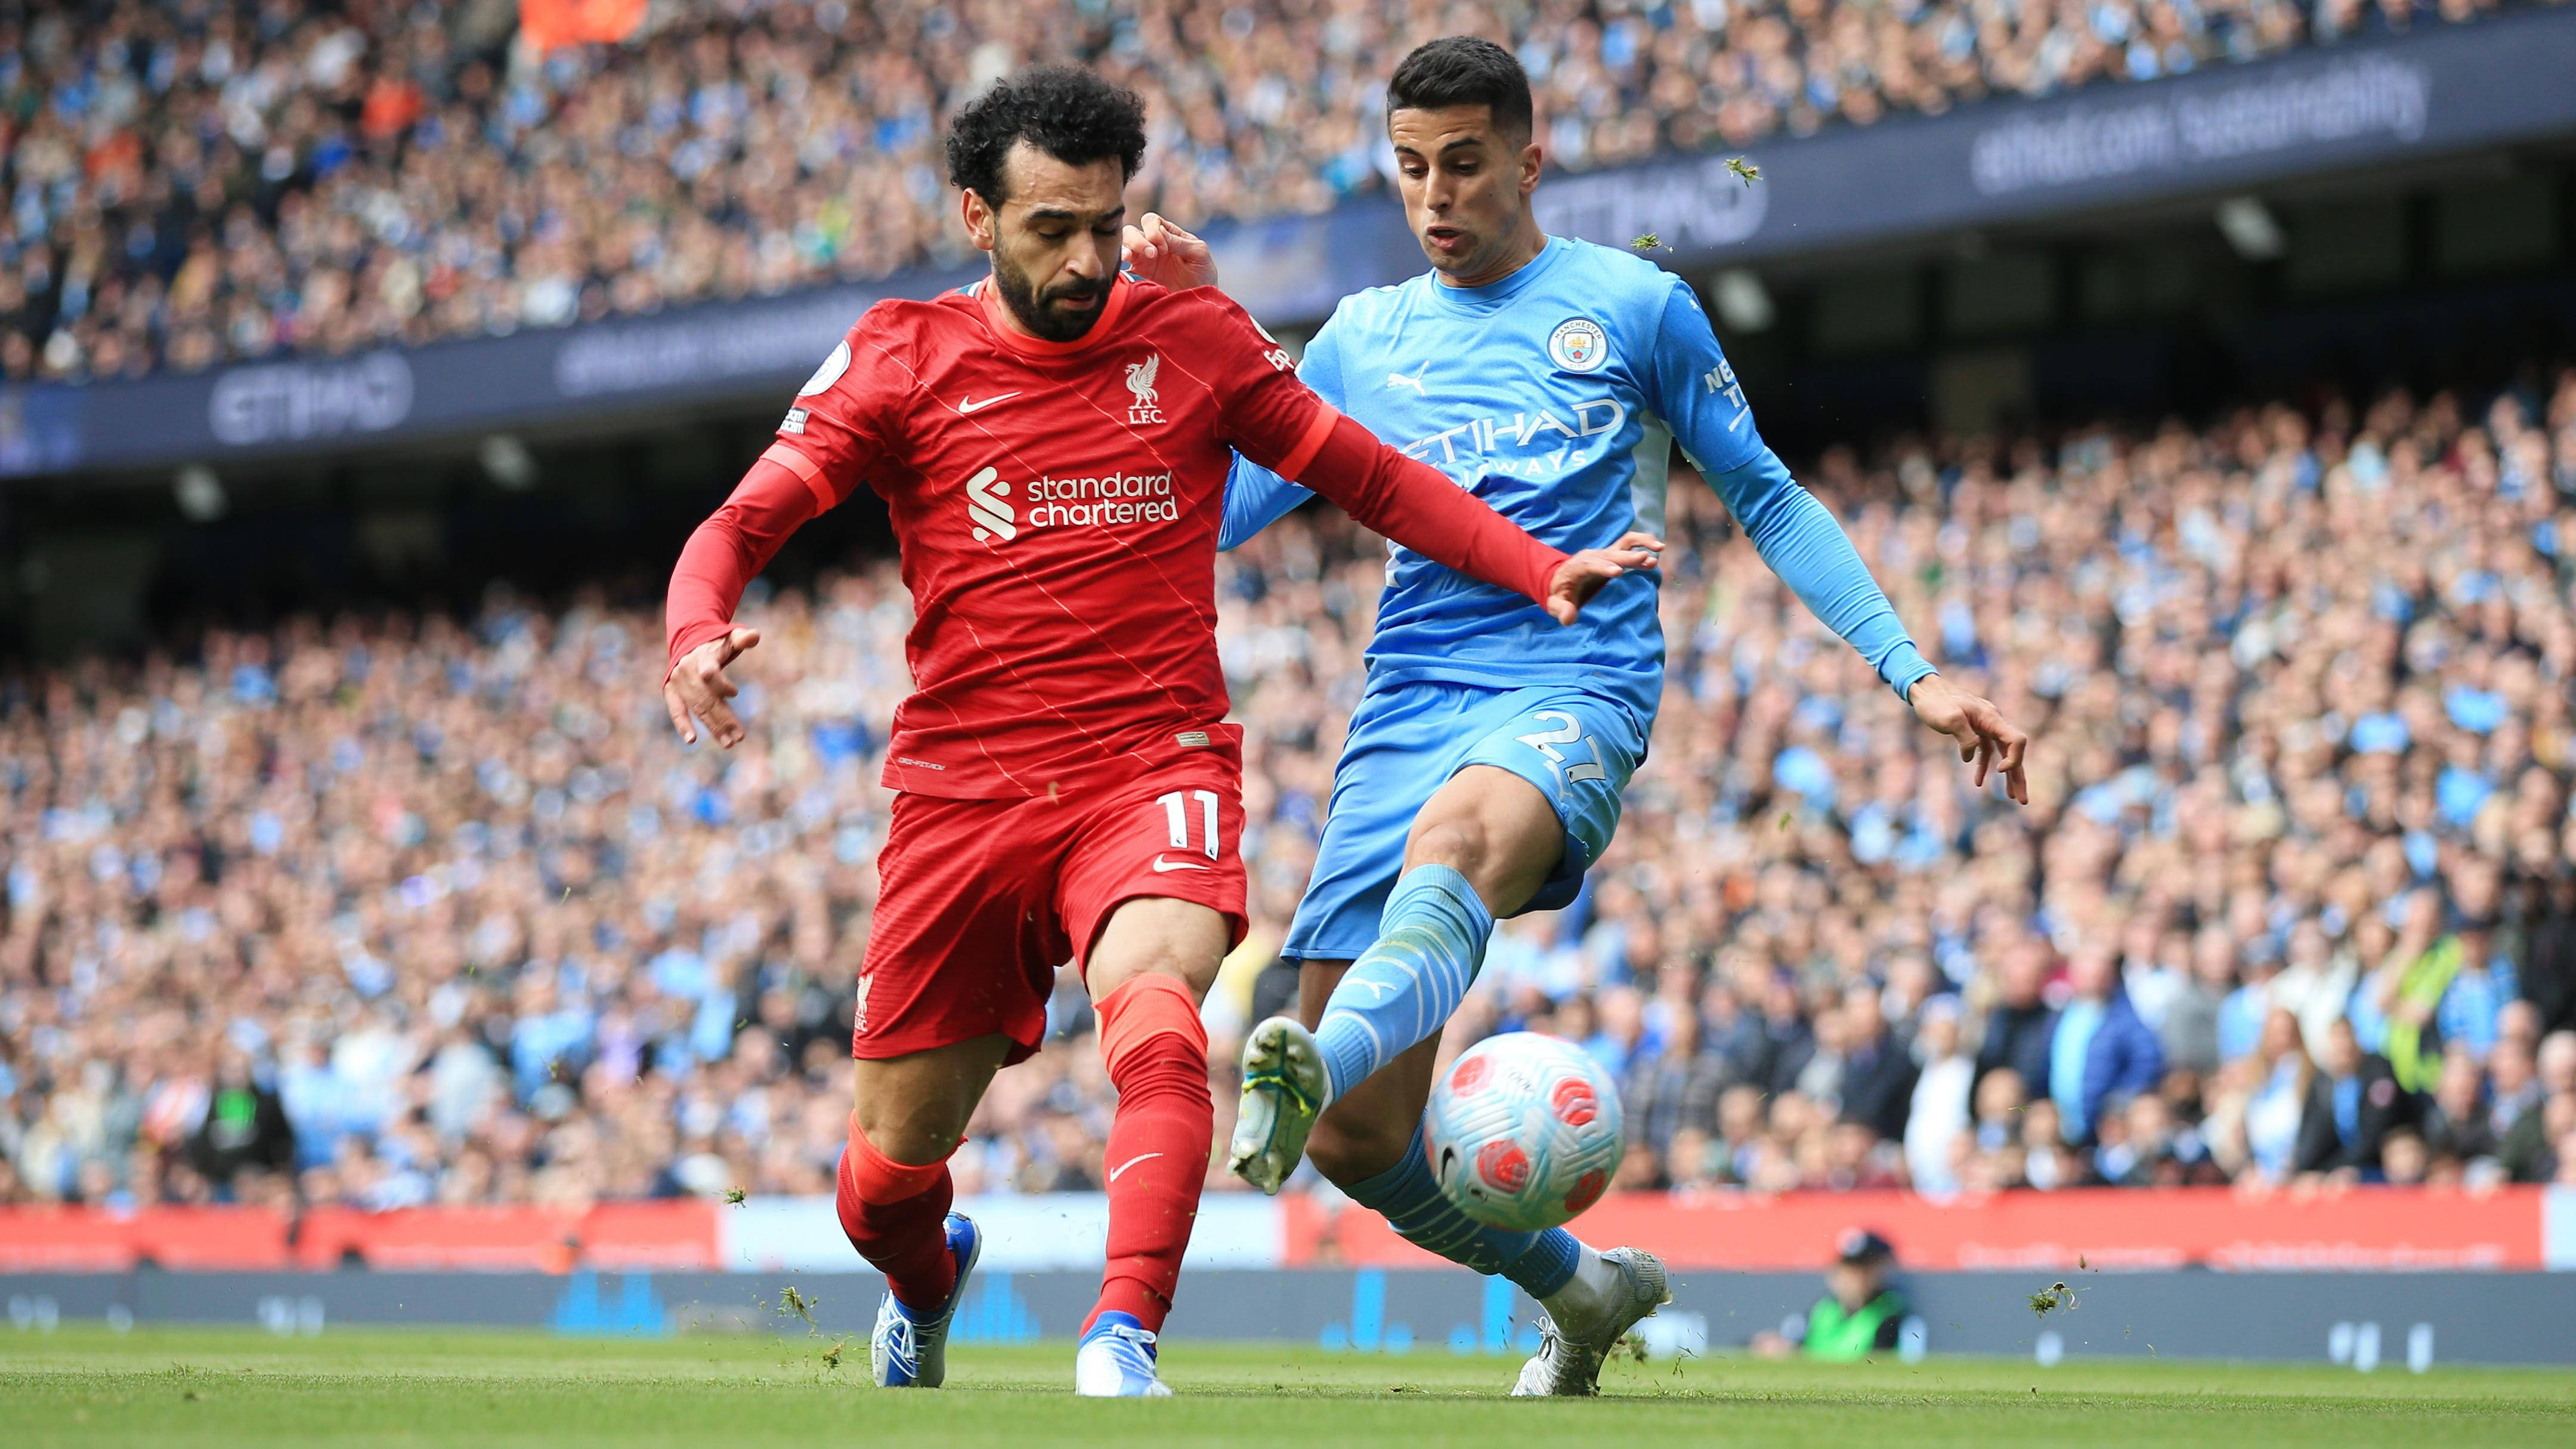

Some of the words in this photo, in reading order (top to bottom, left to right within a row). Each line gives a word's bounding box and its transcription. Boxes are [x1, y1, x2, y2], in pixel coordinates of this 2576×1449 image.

[1554, 321, 1602, 339] MANCHESTER
[1128, 409, 1167, 424] L.F.C.
[1400, 398, 1625, 465] ETIHAD
[1027, 469, 1172, 502] standard
[1028, 495, 1179, 527] chartered
[1513, 710, 1606, 784] 27
[1155, 789, 1220, 862] 11
